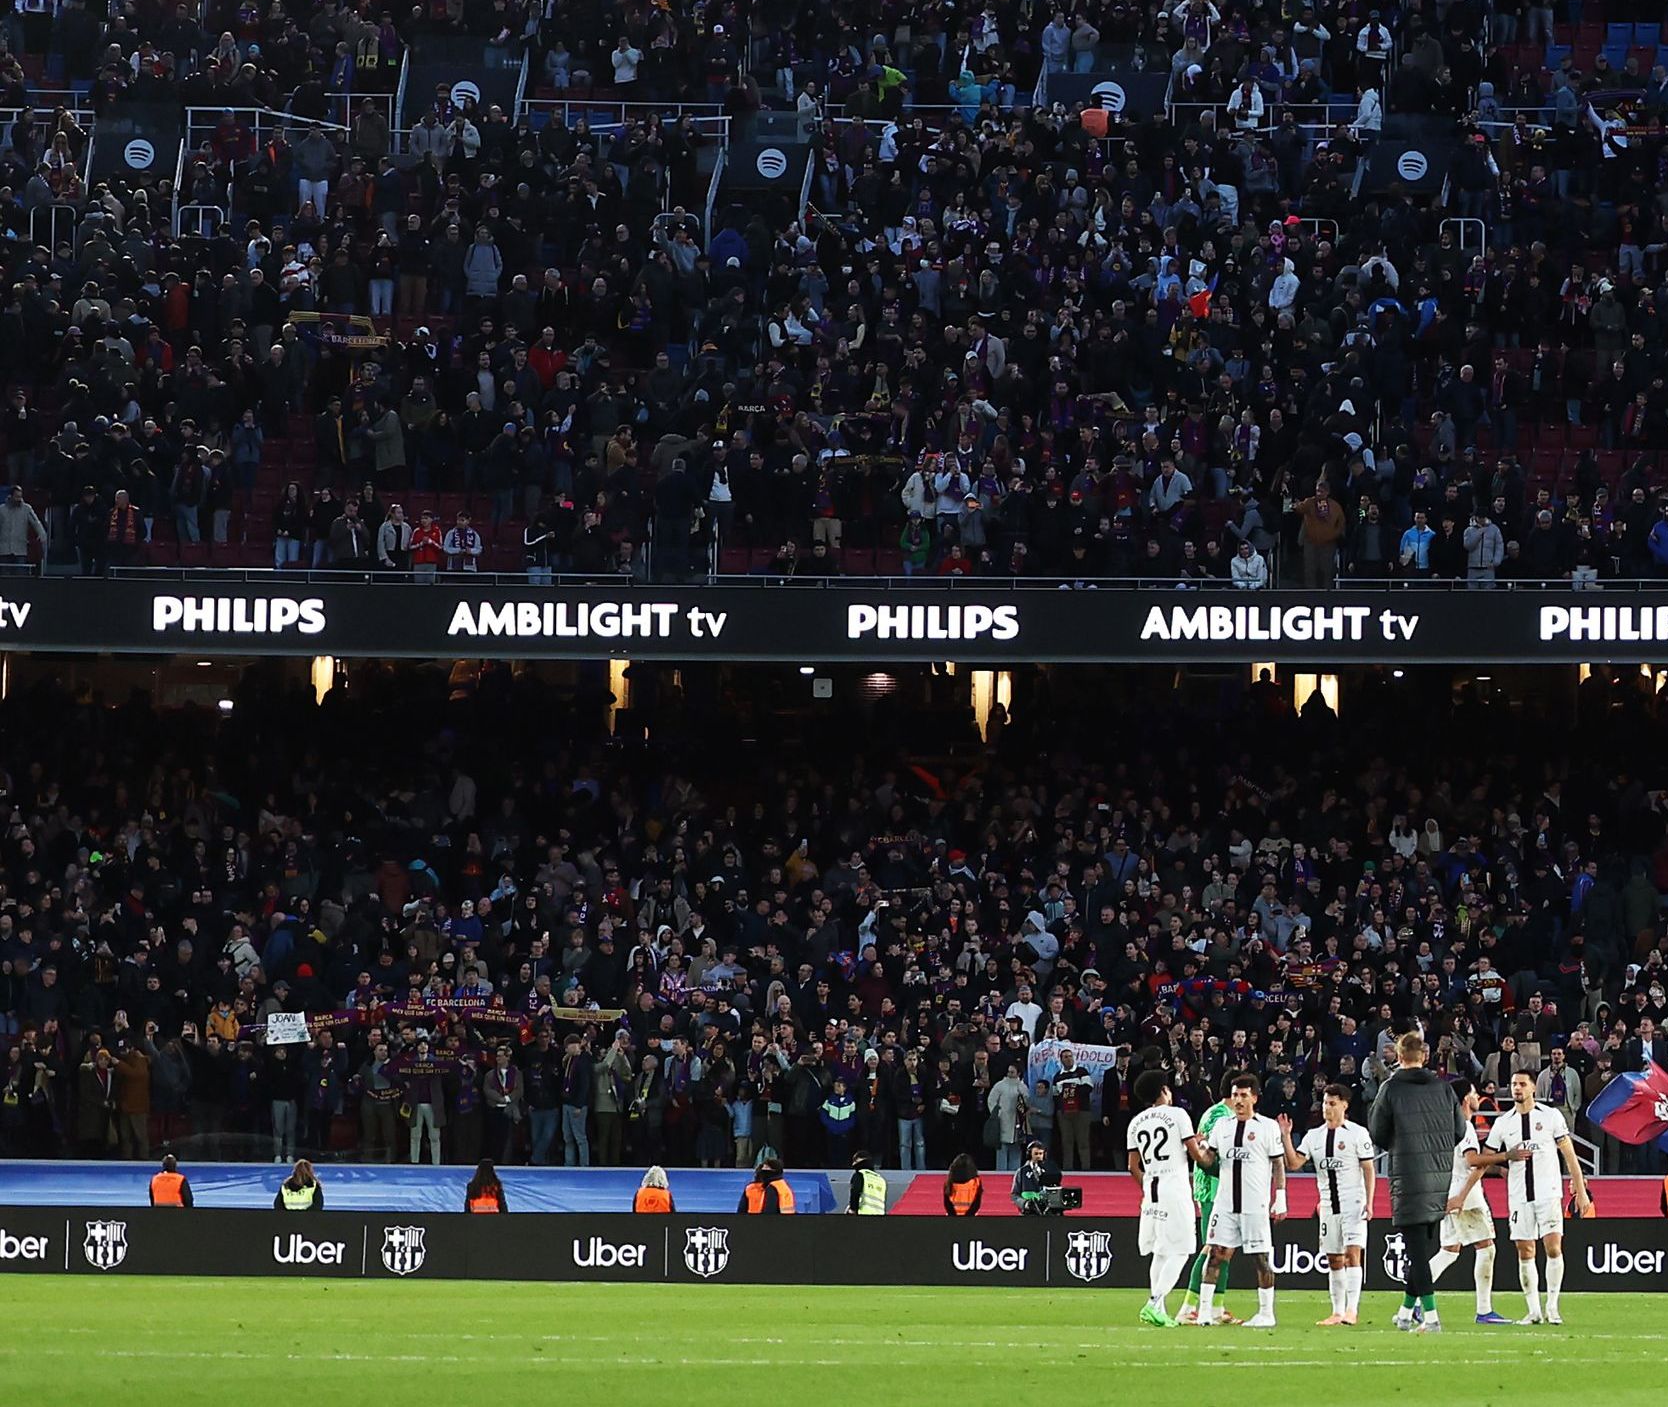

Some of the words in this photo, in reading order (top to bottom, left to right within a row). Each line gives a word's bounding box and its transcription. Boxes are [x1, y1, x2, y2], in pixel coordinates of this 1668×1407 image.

[154, 597, 325, 633] PHILIPS
[448, 602, 678, 636] AMBILIGHT
[687, 607, 726, 637] tv
[848, 605, 1019, 639] PHILIPS
[1141, 606, 1370, 640] AMBILIGHT
[1380, 610, 1418, 640] tv
[426, 999, 436, 1007] FC
[438, 998, 485, 1007] BARCELONA
[1137, 1126, 1170, 1165] 22
[0, 1229, 48, 1258] ber
[274, 1234, 345, 1263] Uber
[574, 1237, 646, 1266] Uber
[953, 1241, 1027, 1270] Uber
[1271, 1244, 1329, 1273] Ube
[1588, 1244, 1664, 1273] Uber
